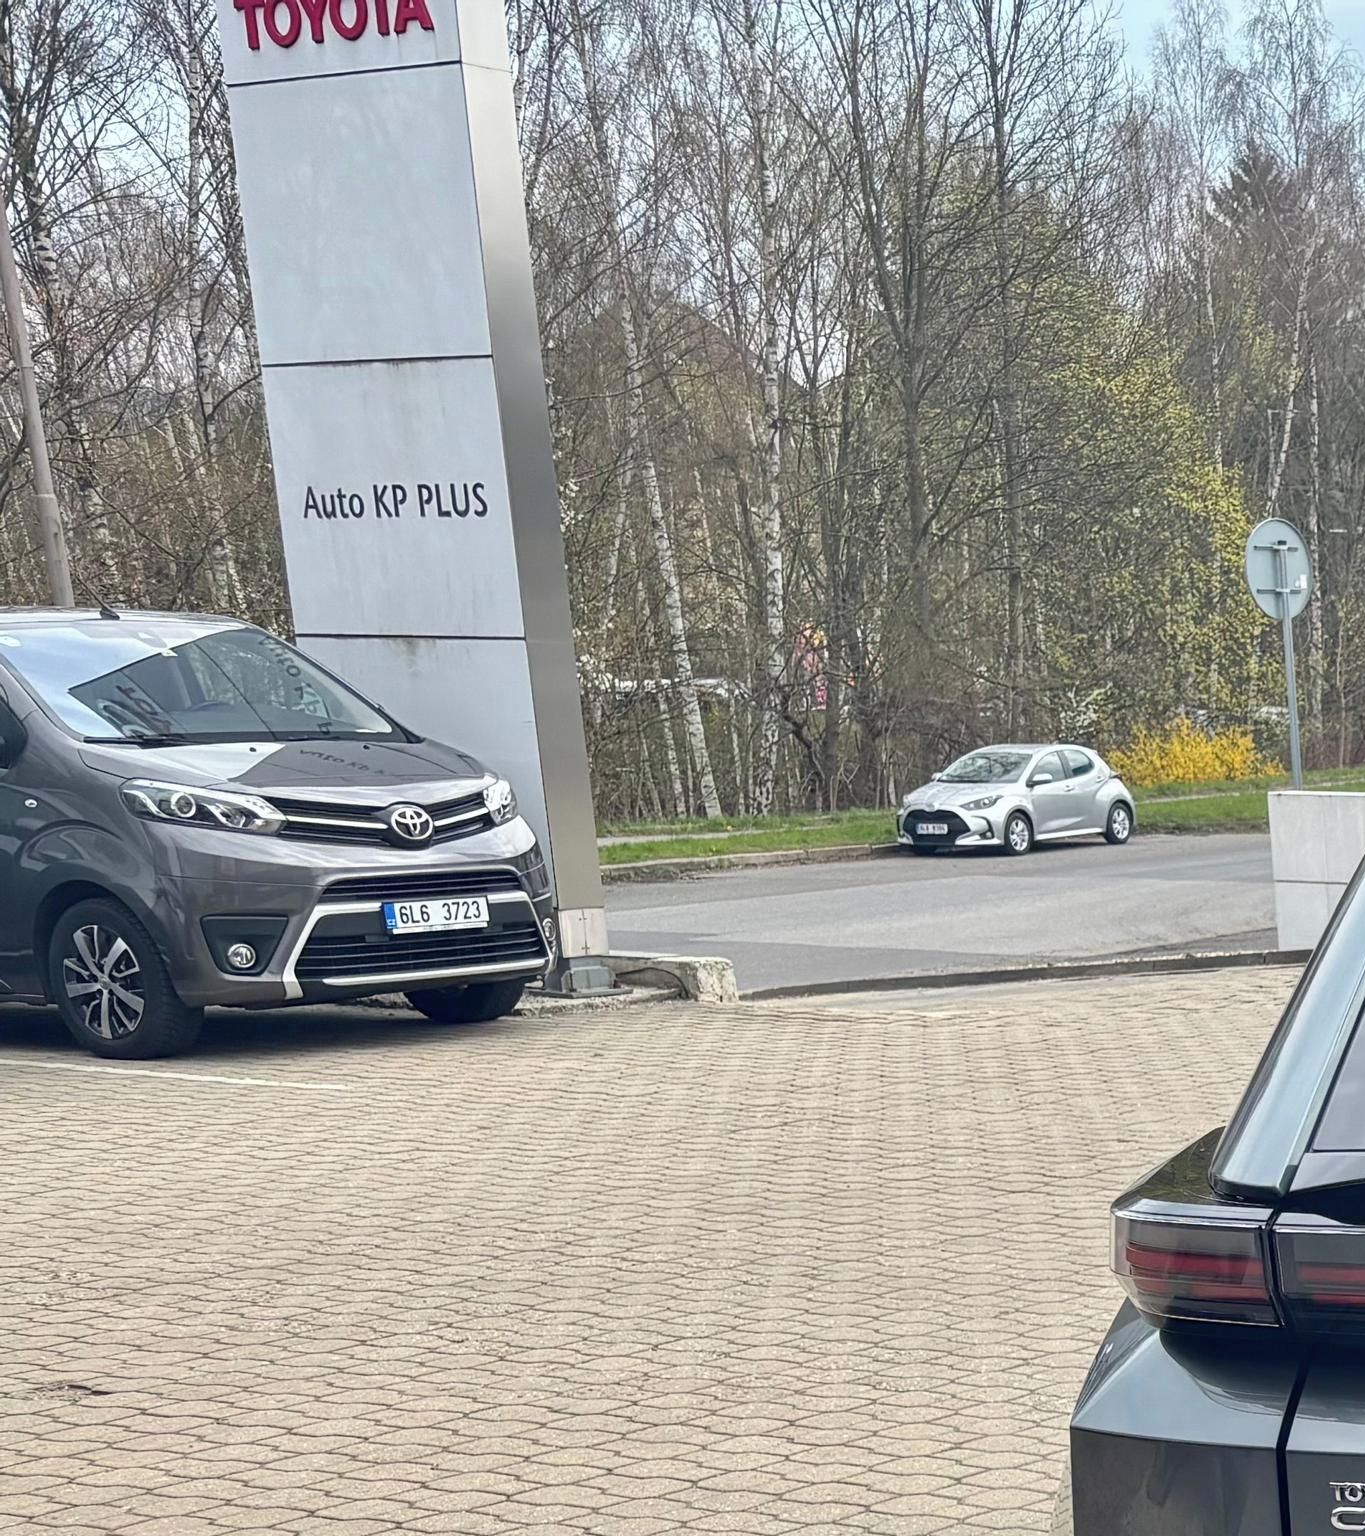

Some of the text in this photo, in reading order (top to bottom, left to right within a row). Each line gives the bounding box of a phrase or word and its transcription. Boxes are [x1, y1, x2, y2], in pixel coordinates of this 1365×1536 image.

[233, 0, 436, 50] TOYOTA
[303, 482, 489, 519] Auto KP PLUS
[399, 904, 431, 925] 6L6
[442, 900, 482, 921] 3723
